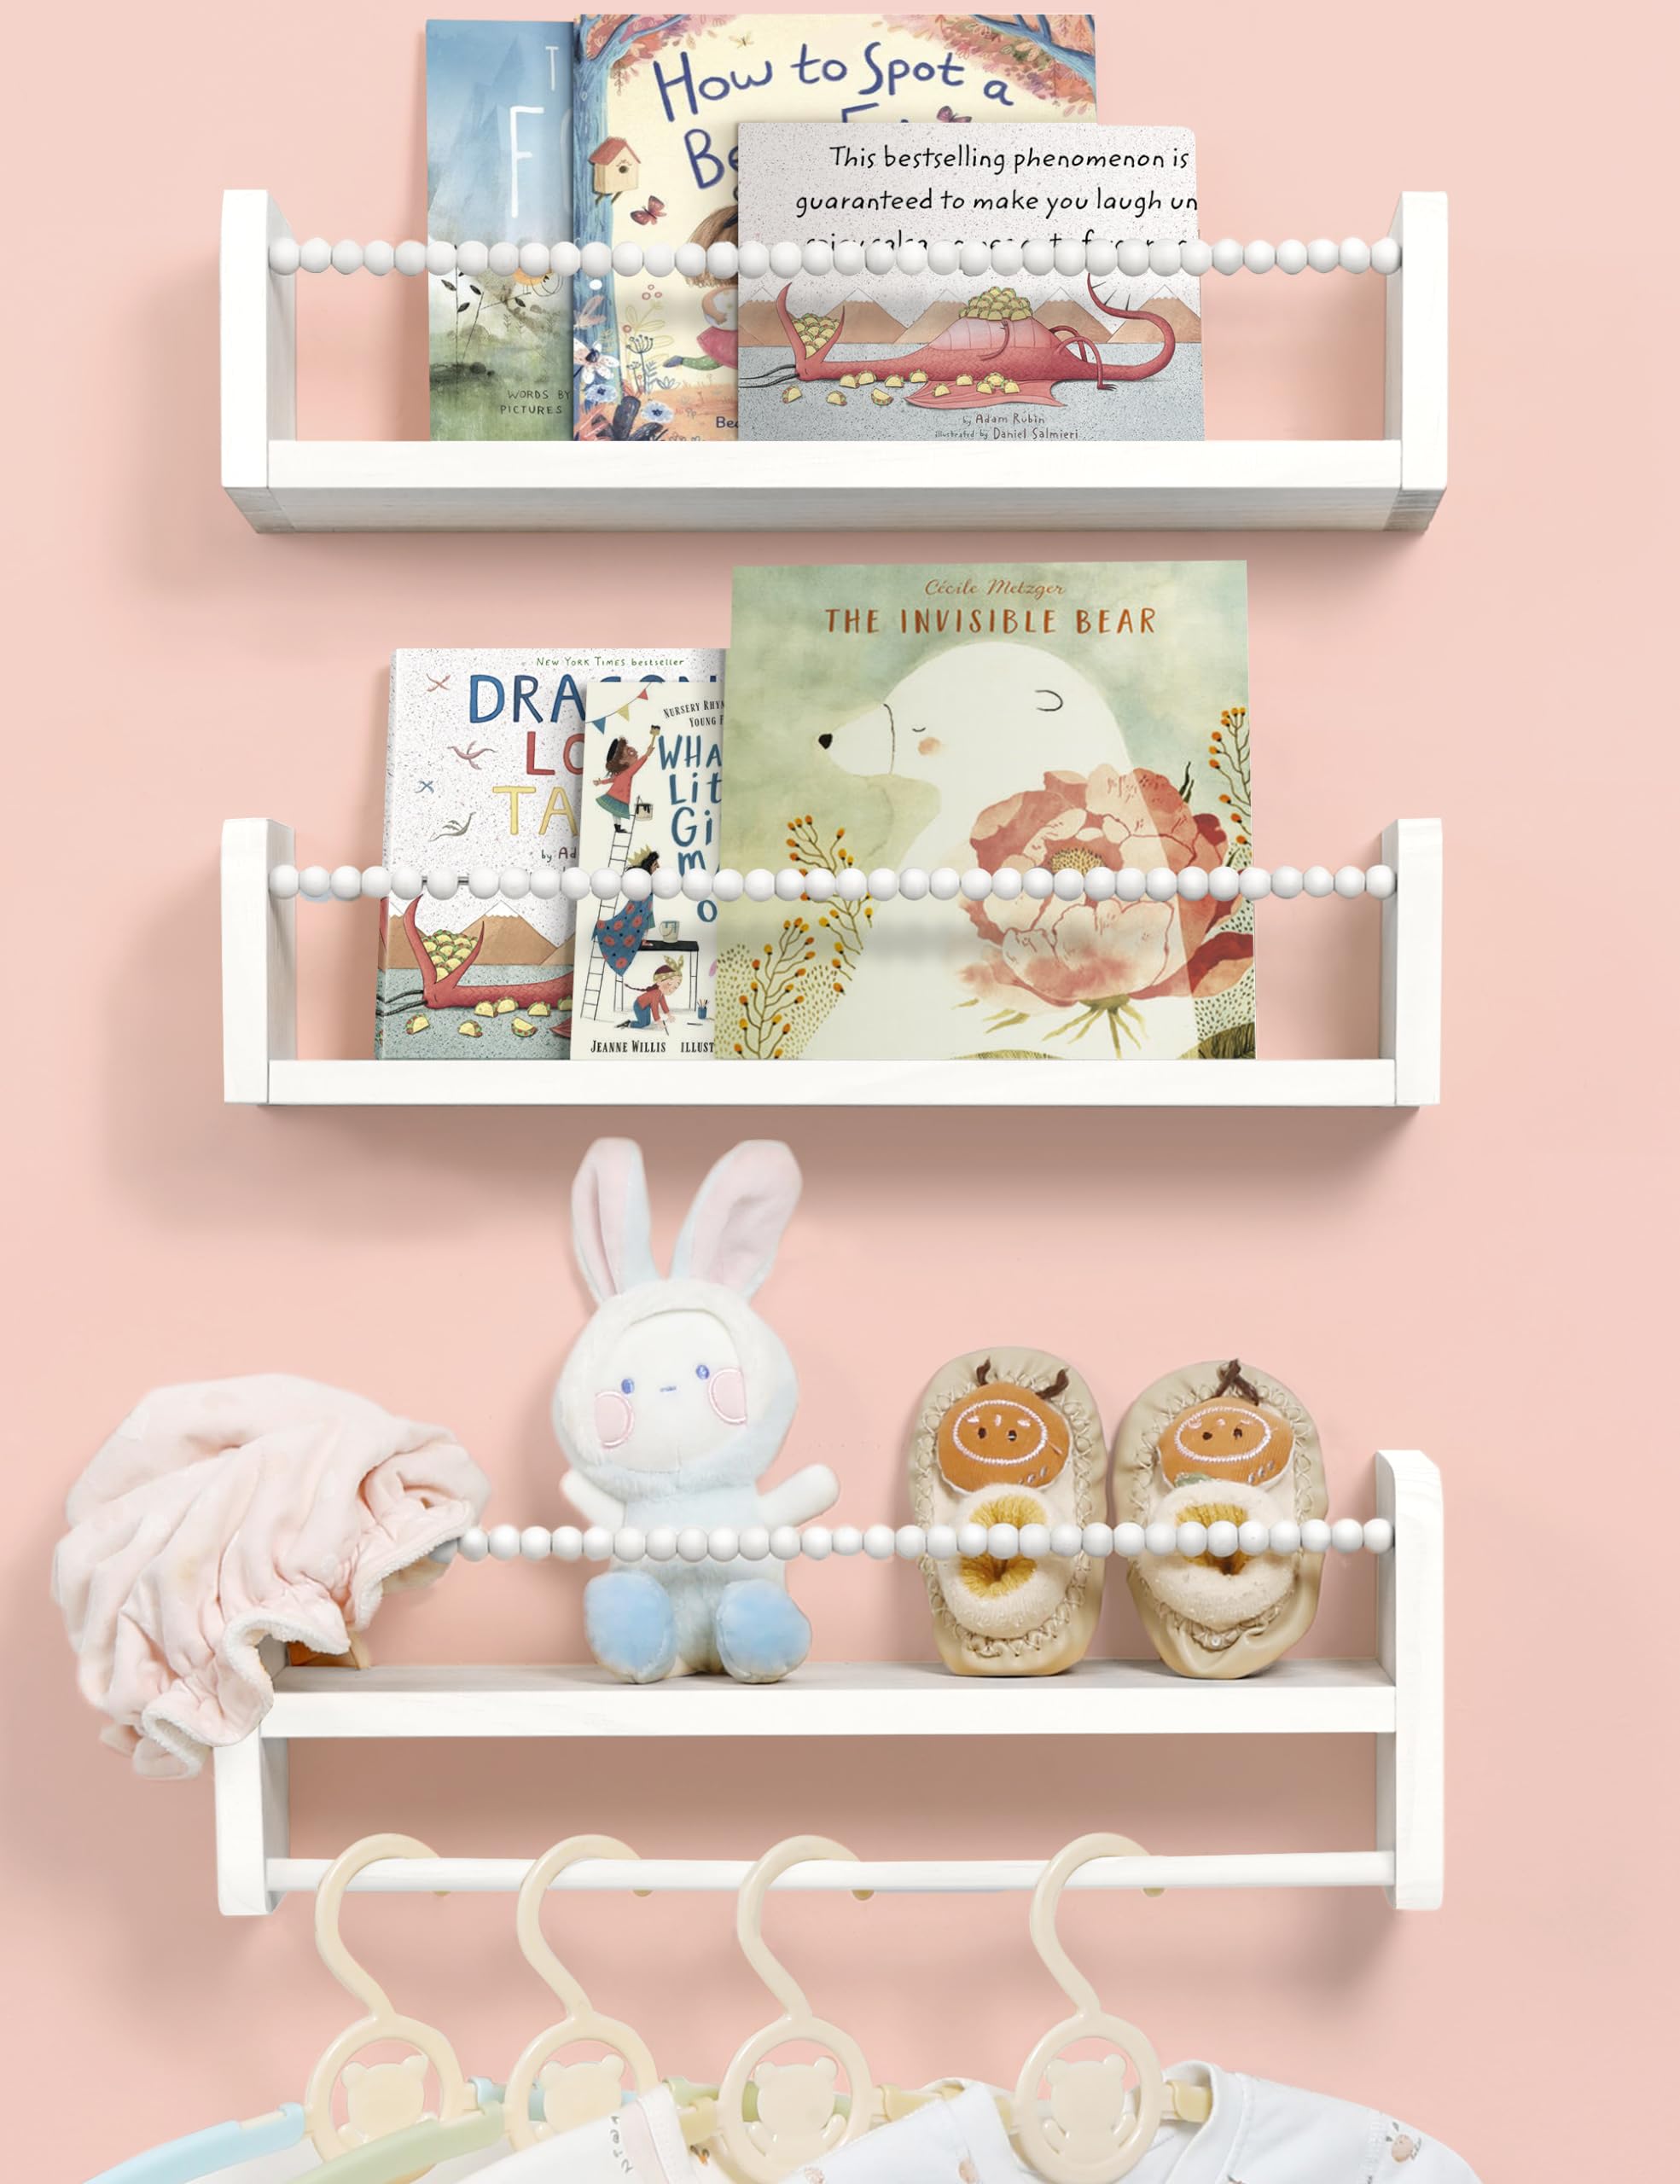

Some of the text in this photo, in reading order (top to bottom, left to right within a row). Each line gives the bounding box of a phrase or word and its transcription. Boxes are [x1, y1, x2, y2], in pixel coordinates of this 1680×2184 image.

[545, 46, 559, 91] T
[654, 42, 1014, 122] How to Spot a
[829, 144, 1189, 175] This bestselling phenomenon is
[795, 188, 933, 218] guaranteed
[940, 190, 964, 210] to
[973, 187, 1039, 211] make
[1046, 195, 1088, 218] you
[1097, 188, 1161, 217] laugh
[507, 389, 572, 399] WORDS BY
[500, 404, 562, 415] PICTURES
[962, 413, 1045, 426] by Adam Rubin
[934, 427, 1078, 440] illustrated by Daniel Salmieri
[925, 579, 1065, 601] Cécile Metzger
[825, 607, 1156, 634] THE INVISIBLE BEAR
[631, 658, 684, 667] bestseller
[663, 702, 700, 718] NURSERY
[689, 716, 717, 728] YOUNG
[671, 806, 712, 847] Gi
[541, 845, 577, 863] by Ad
[590, 1040, 714, 1053] JEANNE WILLIS ILLUST
